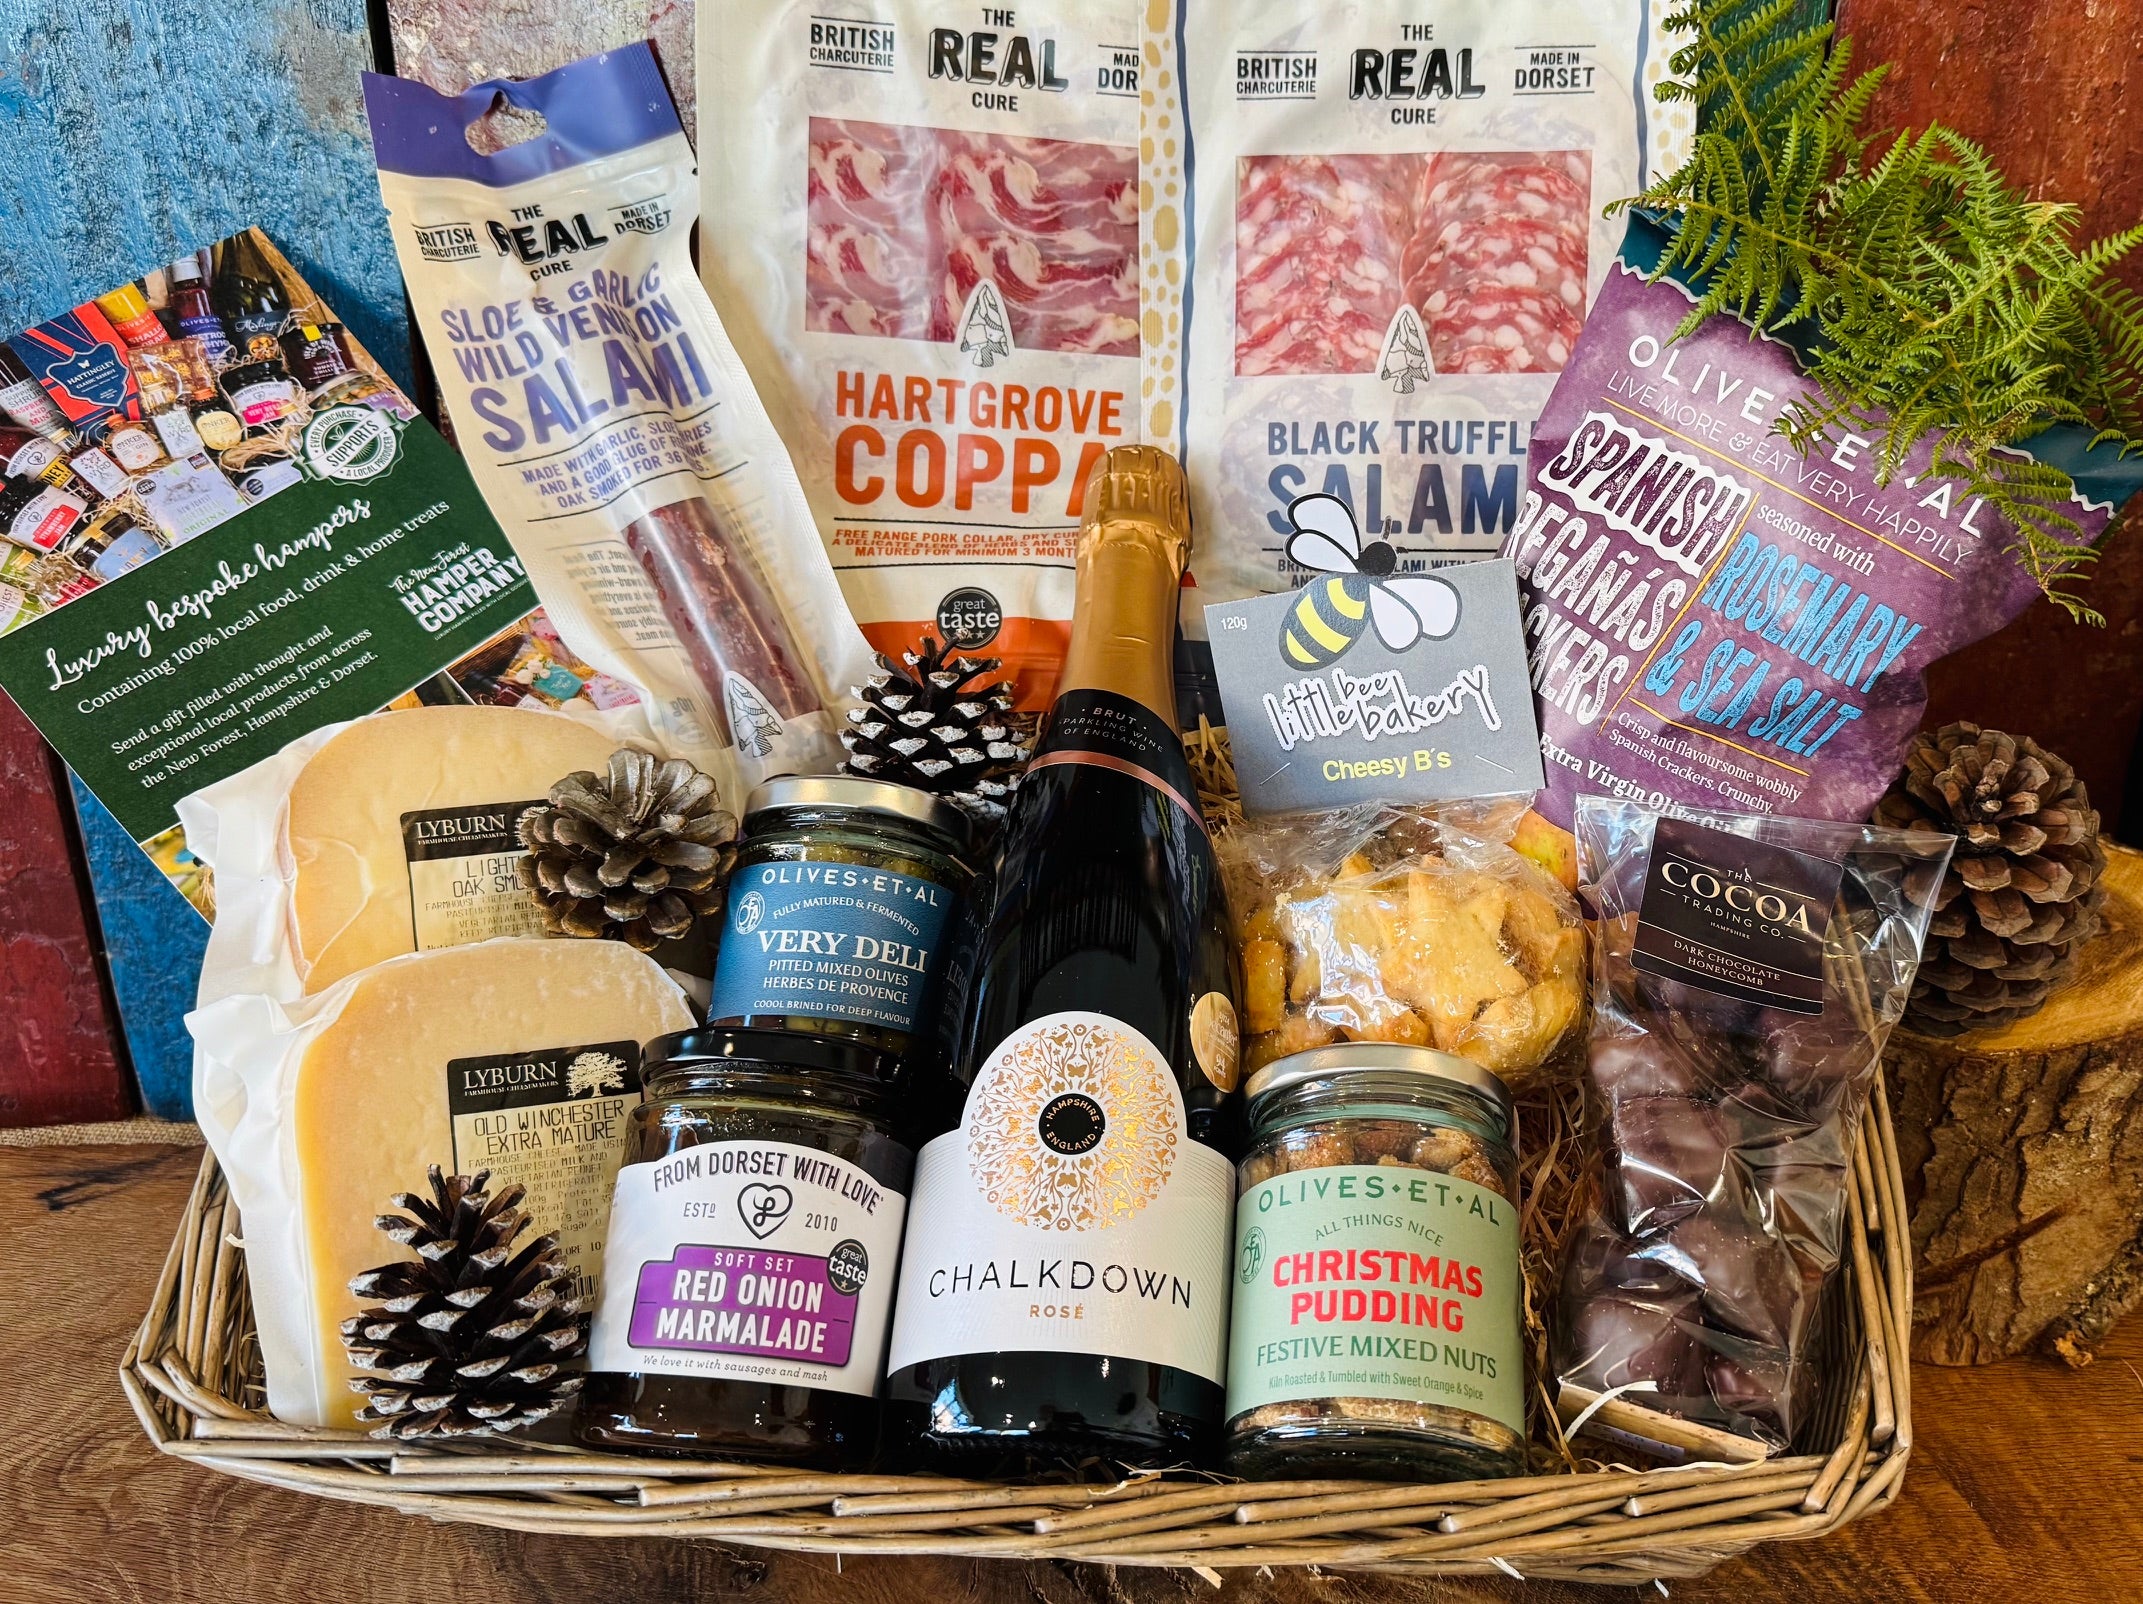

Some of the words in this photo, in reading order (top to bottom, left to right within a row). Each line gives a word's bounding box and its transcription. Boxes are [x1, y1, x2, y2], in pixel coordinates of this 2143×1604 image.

[982, 8, 1015, 28] THE
[1401, 24, 1433, 42] THE
[810, 23, 894, 52] BRITISH
[810, 46, 894, 67] CHARCUTERIE
[928, 28, 1068, 92] REAL
[1237, 58, 1317, 78] BRITISH
[1236, 80, 1316, 94] CHARCUTERIE
[1349, 48, 1486, 100] REAL
[1514, 67, 1595, 89] DORSET
[972, 92, 1018, 112] CURE
[1391, 108, 1436, 124] CURE
[511, 204, 543, 223] THE
[614, 209, 672, 235] DORSET
[415, 228, 476, 249] BRITISH
[421, 243, 480, 258] CHARCUTERIE
[485, 214, 609, 265] REAL
[530, 260, 573, 282] CURE
[440, 300, 524, 343] SLOE
[568, 261, 661, 308] GARLIC
[67, 360, 115, 385] HATTINGLEY
[452, 331, 544, 383] WILD
[470, 331, 713, 453] SALAMI
[836, 371, 1124, 436] HARTGROVE
[326, 419, 379, 467] SUPPORTS
[1267, 421, 1380, 455] BLACK
[1395, 420, 1535, 454] TRUFFL
[1607, 370, 1654, 408] LIVE
[1655, 399, 1731, 443] MORE
[1751, 442, 1796, 476] EAT
[1795, 459, 1866, 509] VERY
[1862, 498, 1974, 566] HAPPILY
[1546, 419, 1745, 568] SPANISH
[836, 529, 870, 539] FREE
[873, 531, 917, 541] RANGE
[922, 533, 957, 543] PORK
[1757, 502, 1838, 555] seasoned
[1832, 544, 1876, 576] with
[47, 623, 152, 691] Luxury
[146, 560, 259, 631] bespoke
[255, 499, 371, 570] hampers
[400, 548, 499, 615] HAMPER
[419, 556, 525, 632] COMPANY
[77, 658, 176, 715] Containing
[172, 633, 219, 665] 100%
[217, 610, 261, 640] local
[259, 588, 304, 617] food,
[303, 562, 346, 593] drink
[357, 528, 405, 559] home
[403, 501, 450, 531] treats
[939, 610, 1000, 629] taste
[953, 599, 986, 612] great
[1701, 530, 1923, 695] ROSEMARY
[1221, 616, 1247, 631] 120g
[111, 728, 150, 754] Send
[162, 710, 187, 731] gift
[186, 688, 223, 718] filled
[222, 672, 255, 694] with
[254, 642, 306, 676] thought
[307, 625, 334, 647] and
[128, 723, 207, 771] exceptional
[204, 704, 240, 728] local
[240, 672, 298, 712] products
[297, 653, 332, 680] from
[332, 628, 372, 657] across
[1336, 673, 1388, 700] bee
[1679, 638, 1770, 730] SEA
[1748, 677, 1862, 758] SALT
[141, 771, 166, 788] the
[165, 753, 199, 775] New
[199, 728, 248, 757] Forest,
[244, 686, 319, 731] Hampshire
[329, 651, 378, 682] Dorset.
[1093, 707, 1137, 725] BRUT
[1268, 682, 1354, 745] little
[1357, 670, 1495, 735] bakery
[1323, 754, 1406, 781] Cheesy
[1609, 729, 1658, 763] Spanish
[1657, 757, 1715, 790] Crackers.
[1717, 781, 1773, 814] Crunchy.
[1618, 712, 1651, 740] Crisp
[1650, 734, 1674, 752] and
[1676, 742, 1754, 783] flavoursome
[1755, 773, 1802, 804] wobbly
[1586, 759, 1646, 801] Virgin
[415, 814, 506, 839] LYBURN
[1661, 861, 1811, 933] COCOA
[1682, 894, 1752, 928] TRADING
[773, 901, 801, 919] FULLY
[804, 897, 854, 909] MATURED
[866, 902, 919, 936] FERMENTED
[757, 930, 847, 955] VERY
[852, 935, 927, 972] DELI
[1674, 940, 1703, 957] DARK
[1708, 953, 1780, 981] CHOCOLATE
[769, 960, 813, 972] PITTED
[816, 962, 862, 976] MIXED
[865, 968, 908, 987] OLIVES
[1688, 957, 1763, 986] HONEYCOMB
[763, 977, 814, 990] HERBES
[818, 980, 836, 992] DE
[840, 982, 908, 1005] PROVENCE
[754, 1000, 784, 1009] COOOL
[787, 1001, 823, 1010] BRINED
[826, 1004, 845, 1013] FOR
[848, 1006, 872, 1016] DEEP
[875, 1010, 911, 1025] FLAVOUR
[463, 1062, 557, 1090] LYBURN
[474, 1115, 507, 1137] OLD
[518, 1099, 624, 1130] WINCHESTER
[1046, 1098, 1100, 1122] HAMPSHIRE
[486, 1131, 542, 1155] EXTRA
[552, 1120, 616, 1146] MATURE
[1046, 1131, 1096, 1151] ENGLAND
[653, 1156, 700, 1192] FROM
[709, 1151, 787, 1176] DORSET
[793, 1157, 839, 1191] WITH
[841, 1173, 880, 1216] LOVE
[805, 1213, 838, 1232] 2010
[1315, 1221, 1341, 1240] ALL
[1342, 1214, 1403, 1229] THINGS
[1408, 1220, 1444, 1247] NICE
[714, 1252, 755, 1270] SOFT
[765, 1257, 794, 1273] SET
[829, 1254, 867, 1285] taste
[841, 1247, 863, 1265] great
[929, 1260, 1191, 1309] CHALKDOWN
[1273, 1248, 1484, 1299] CHRISTMAS
[673, 1269, 727, 1303] RED
[738, 1274, 823, 1313] ONION
[1029, 1303, 1084, 1320] ROSÉ
[1290, 1289, 1464, 1333] PUDDING
[656, 1307, 827, 1353] MARMALADE
[643, 1355, 658, 1366] We
[660, 1357, 681, 1368] love
[696, 1359, 721, 1369] with
[724, 1362, 777, 1376] sausages
[779, 1366, 800, 1378] and
[802, 1369, 828, 1381] mash
[1257, 1336, 1343, 1366] FESTIVE
[1350, 1336, 1438, 1363] MIXED
[1444, 1346, 1497, 1379] NUTS
[1268, 1376, 1282, 1389] Kiln
[1284, 1373, 1318, 1386] Roasted
[1328, 1371, 1366, 1383] Tumbled
[1369, 1371, 1391, 1384] with
[1393, 1373, 1421, 1387] Sweet
[1424, 1376, 1455, 1394] Orange
[1463, 1384, 1484, 1400] Spice
